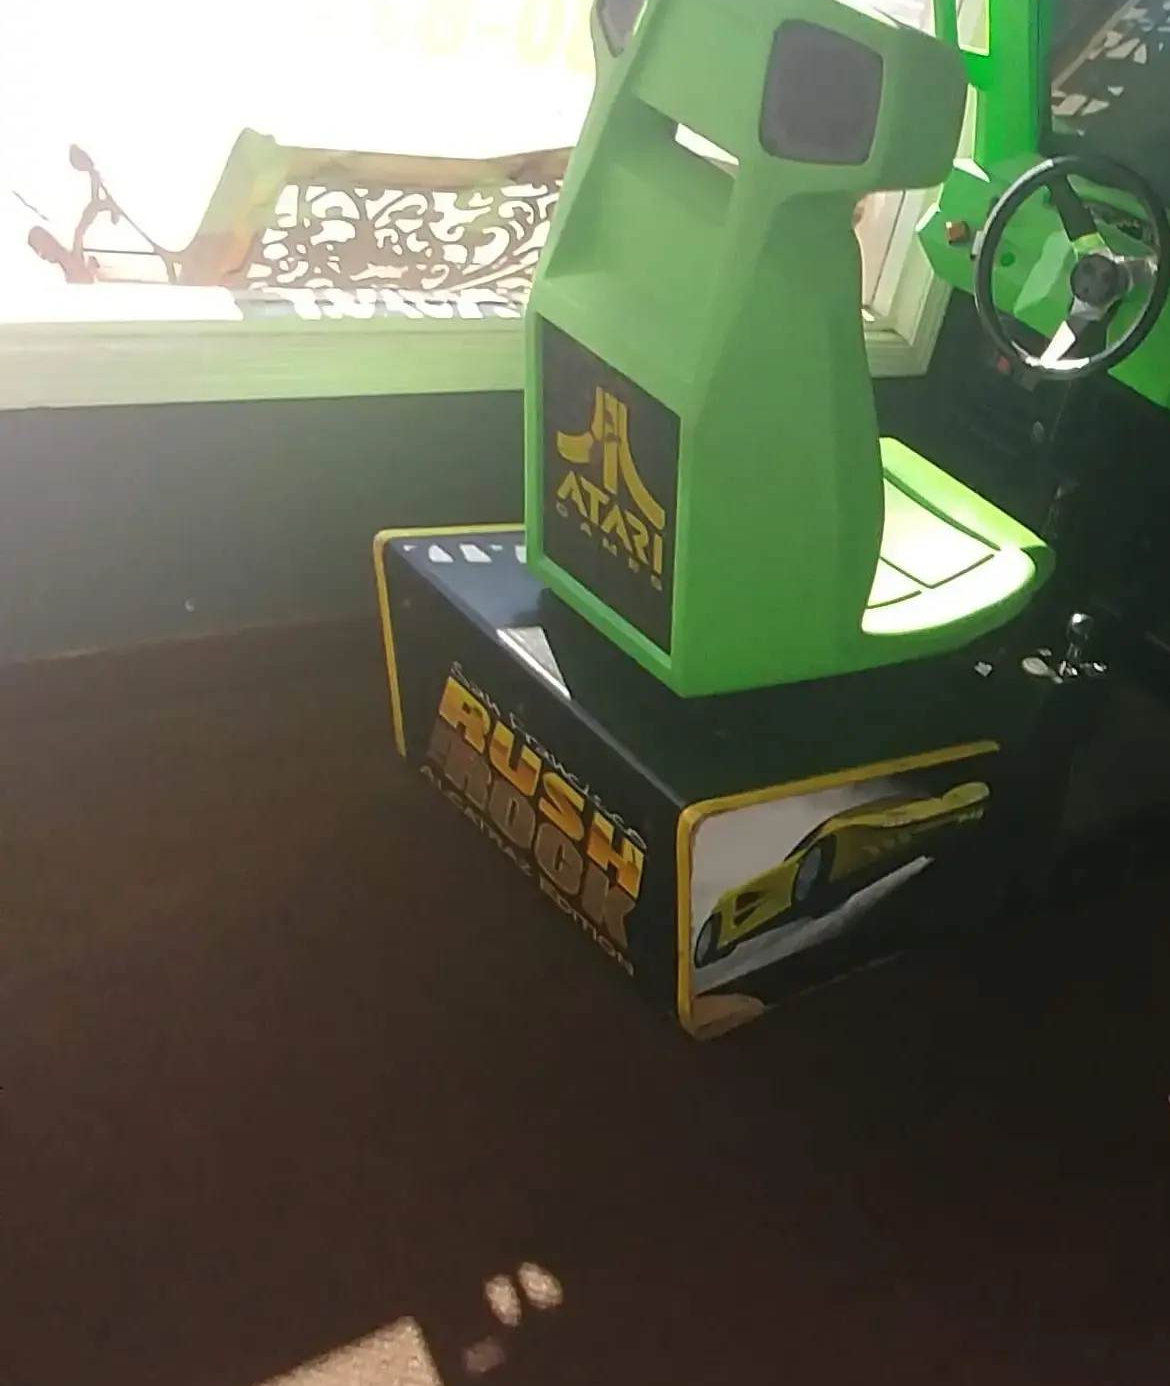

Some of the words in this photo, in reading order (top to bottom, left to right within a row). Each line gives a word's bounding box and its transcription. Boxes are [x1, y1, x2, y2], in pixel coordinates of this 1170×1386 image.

[556, 469, 664, 576] ATARI
[426, 716, 638, 949] ROCK
[438, 675, 645, 901] RUSH
